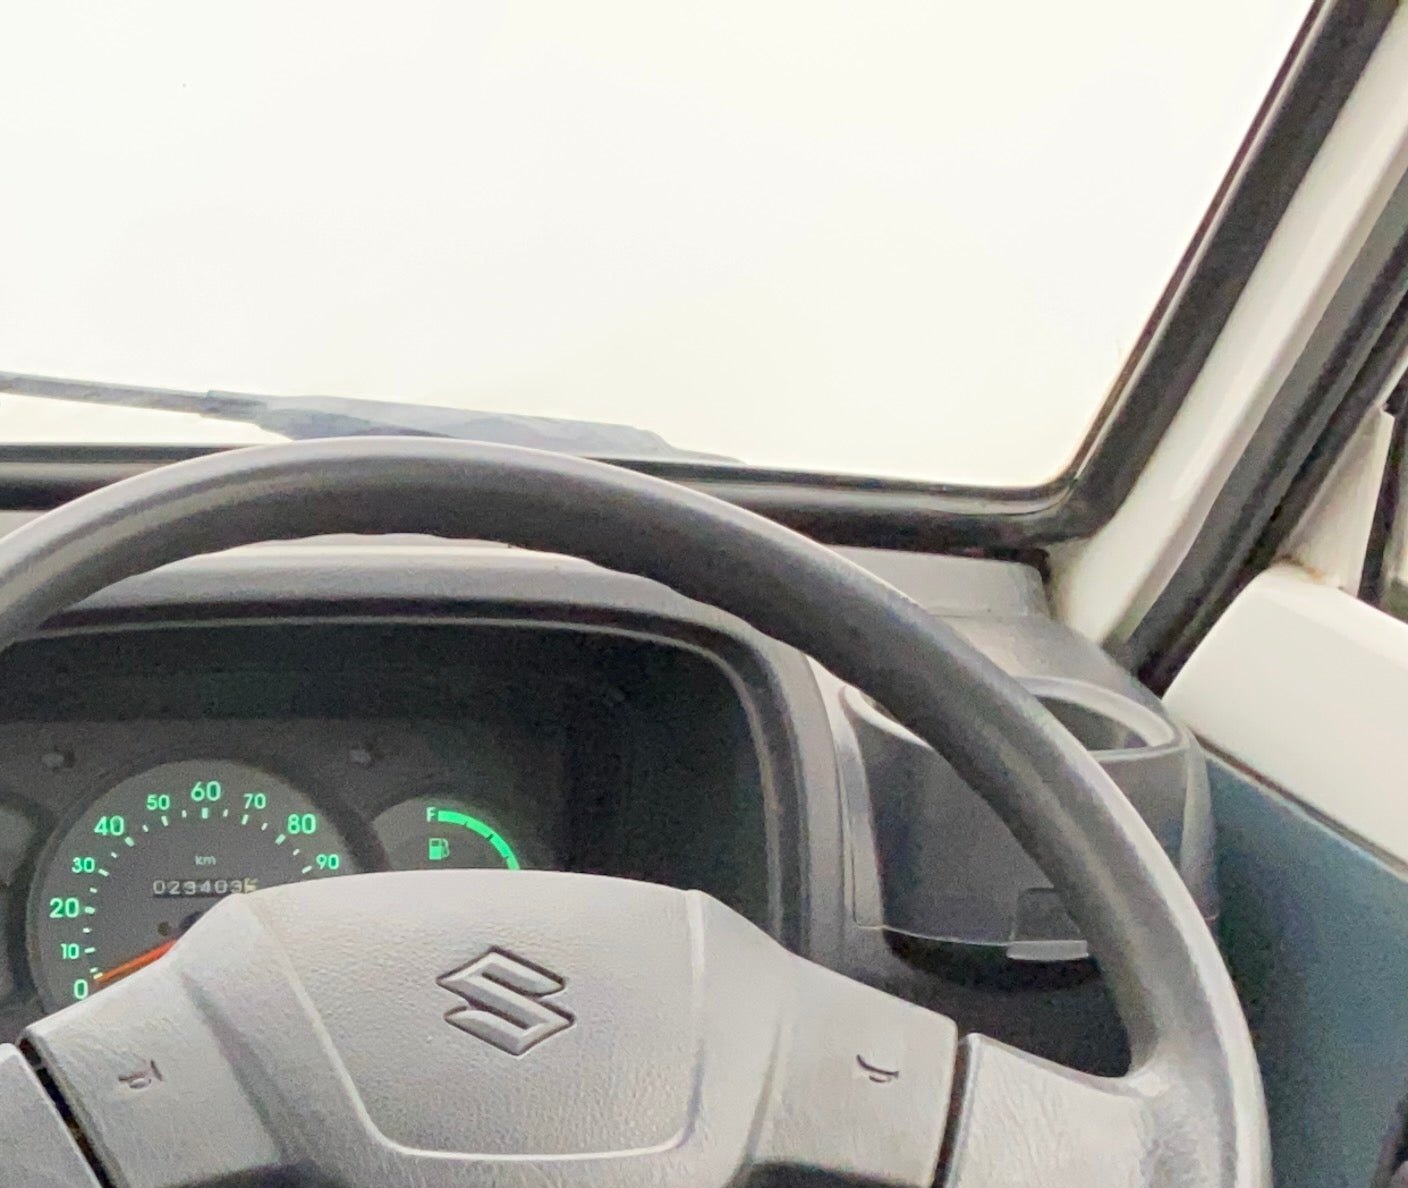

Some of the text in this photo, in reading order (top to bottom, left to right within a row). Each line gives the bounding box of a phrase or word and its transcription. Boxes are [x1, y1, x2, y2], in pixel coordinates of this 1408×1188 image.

[190, 781, 221, 801] 60
[146, 794, 171, 810] 50
[243, 793, 267, 810] 70
[426, 807, 437, 822] F
[94, 816, 125, 836] 40
[287, 813, 317, 834] 80
[71, 857, 95, 873] 30
[195, 856, 217, 866] km
[315, 854, 340, 870] 90
[49, 898, 80, 918] 20
[60, 943, 80, 959] 10
[74, 979, 89, 1000] 0
